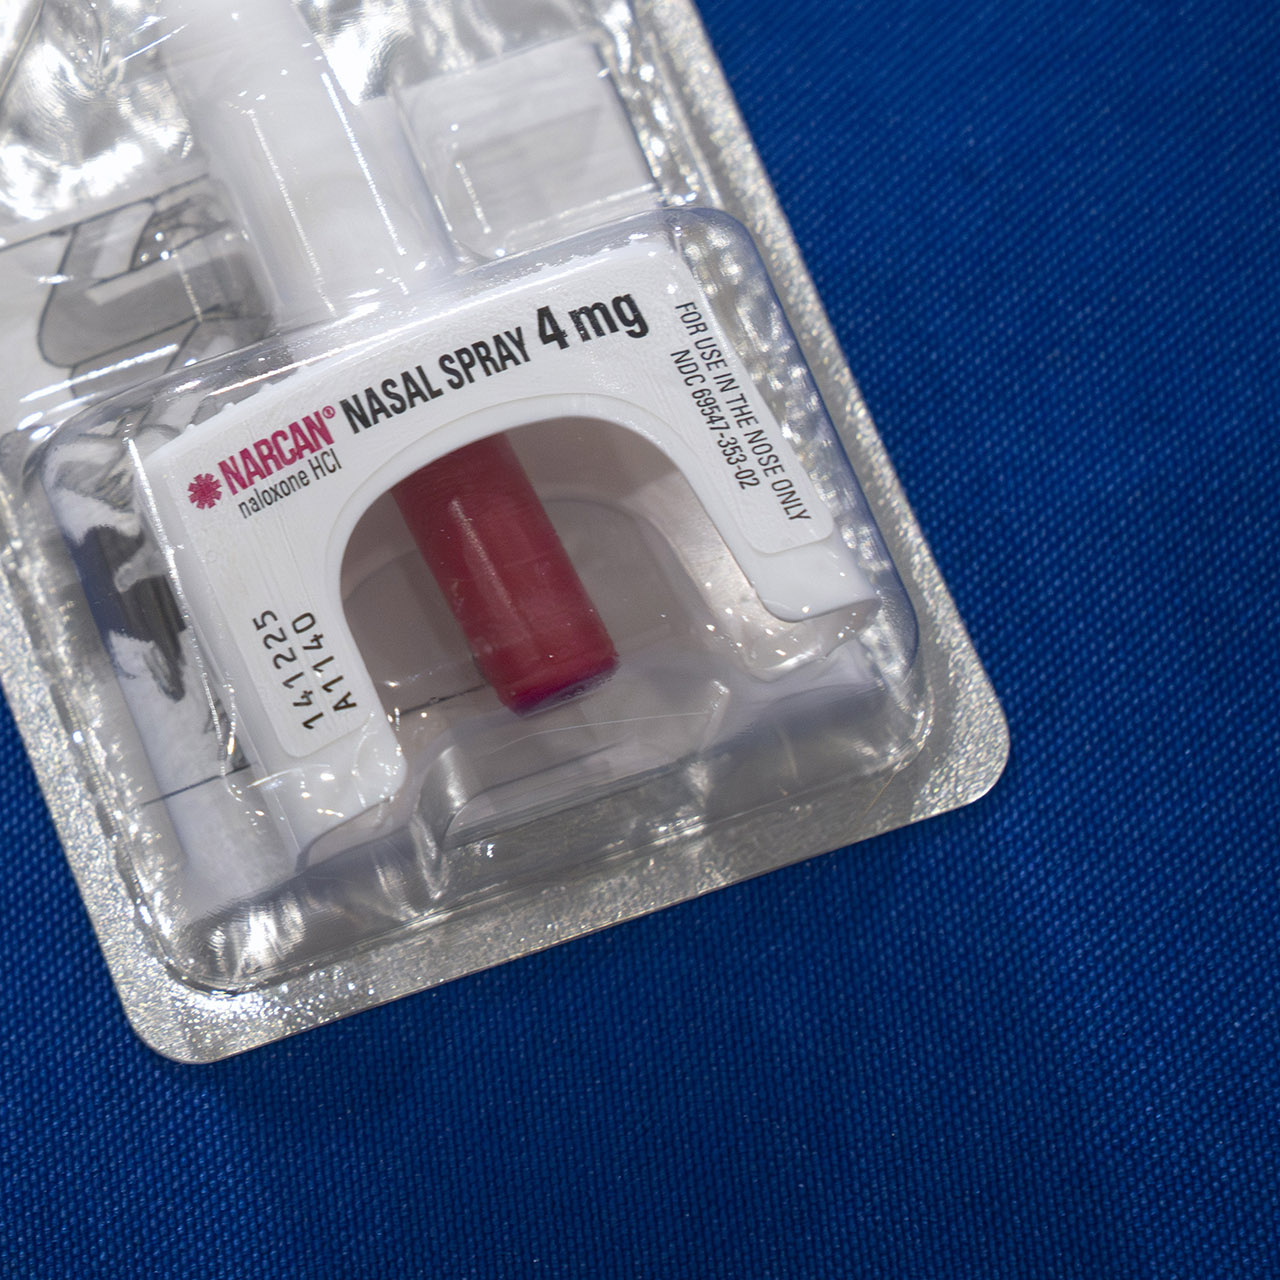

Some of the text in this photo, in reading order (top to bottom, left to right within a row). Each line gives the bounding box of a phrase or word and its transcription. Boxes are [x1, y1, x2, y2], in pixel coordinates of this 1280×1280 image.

[339, 367, 443, 435] NASAL
[438, 326, 532, 391] SPRAY
[535, 306, 570, 352] 4
[565, 292, 650, 344] mg
[670, 349, 761, 490] NDC 69547-353-02
[674, 301, 812, 521] FOR USE IN THE NOSE ONLY
[238, 447, 343, 519] naloxone HCl
[252, 610, 324, 730] 141225
[292, 612, 358, 712] A1140
